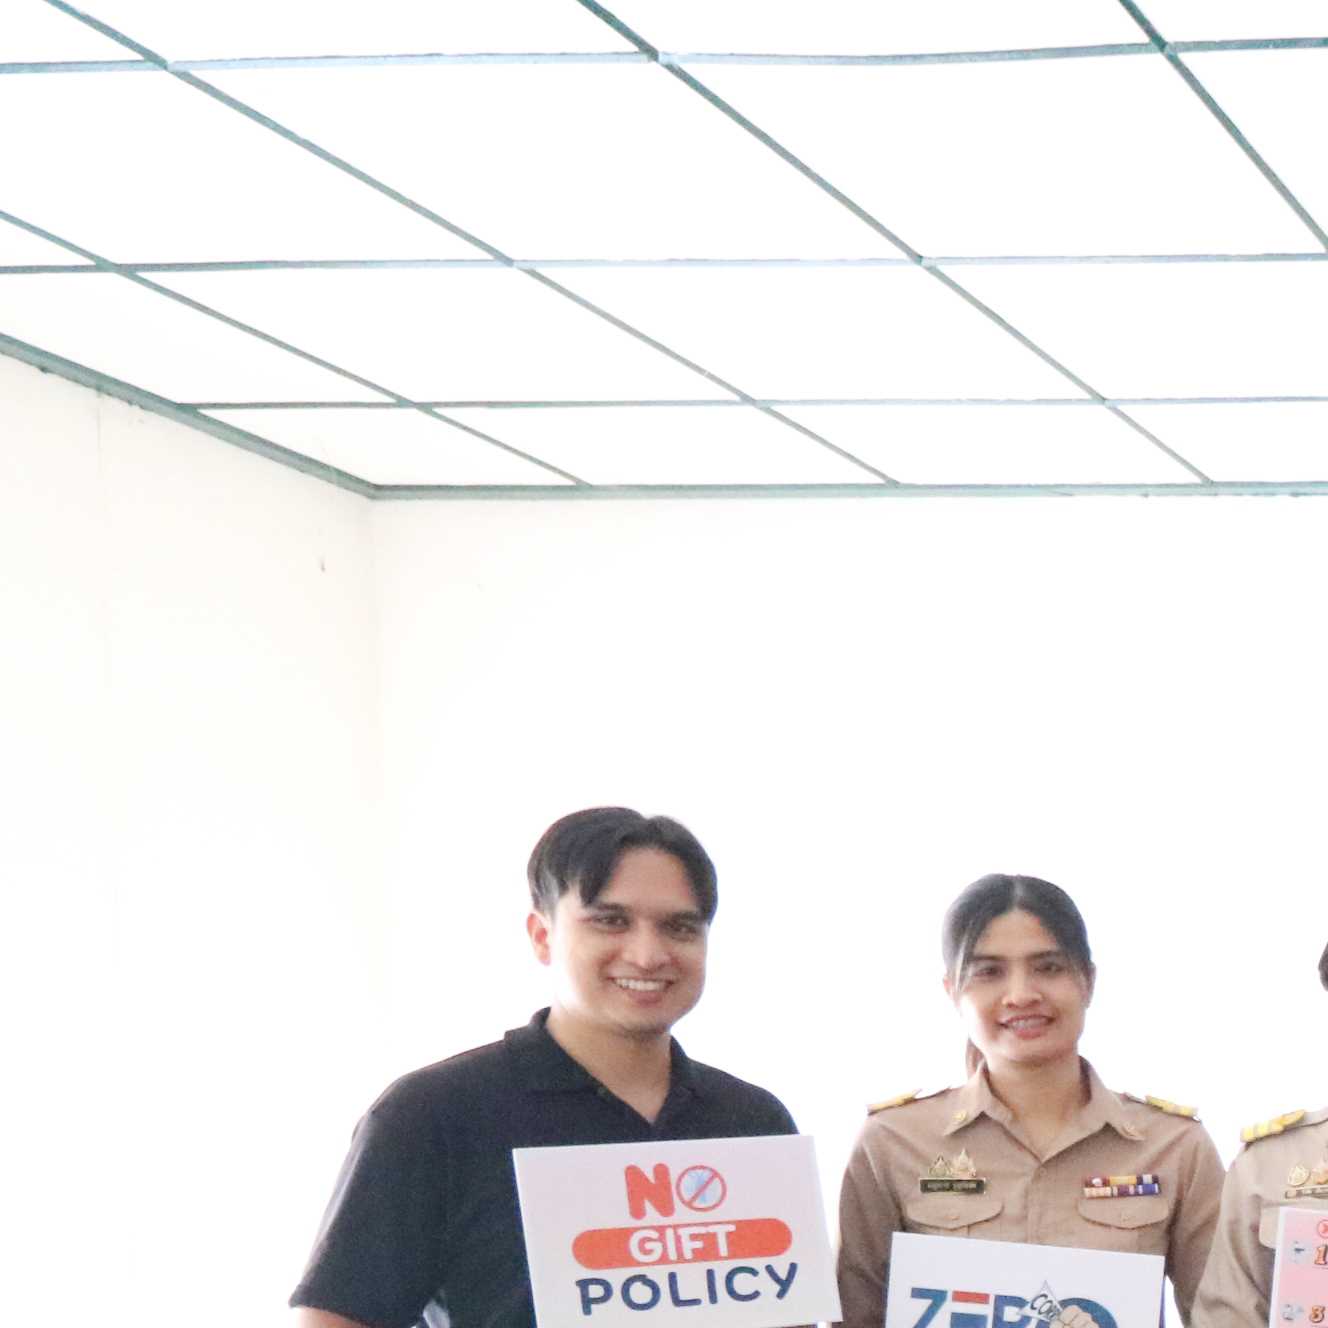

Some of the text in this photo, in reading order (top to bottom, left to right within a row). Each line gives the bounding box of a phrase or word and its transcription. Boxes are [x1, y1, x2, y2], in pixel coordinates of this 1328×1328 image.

[628, 1223, 737, 1263] GIFT
[1314, 1244, 1328, 1266] 1
[575, 1262, 799, 1316] POLICY
[1309, 1305, 1326, 1324] 3
